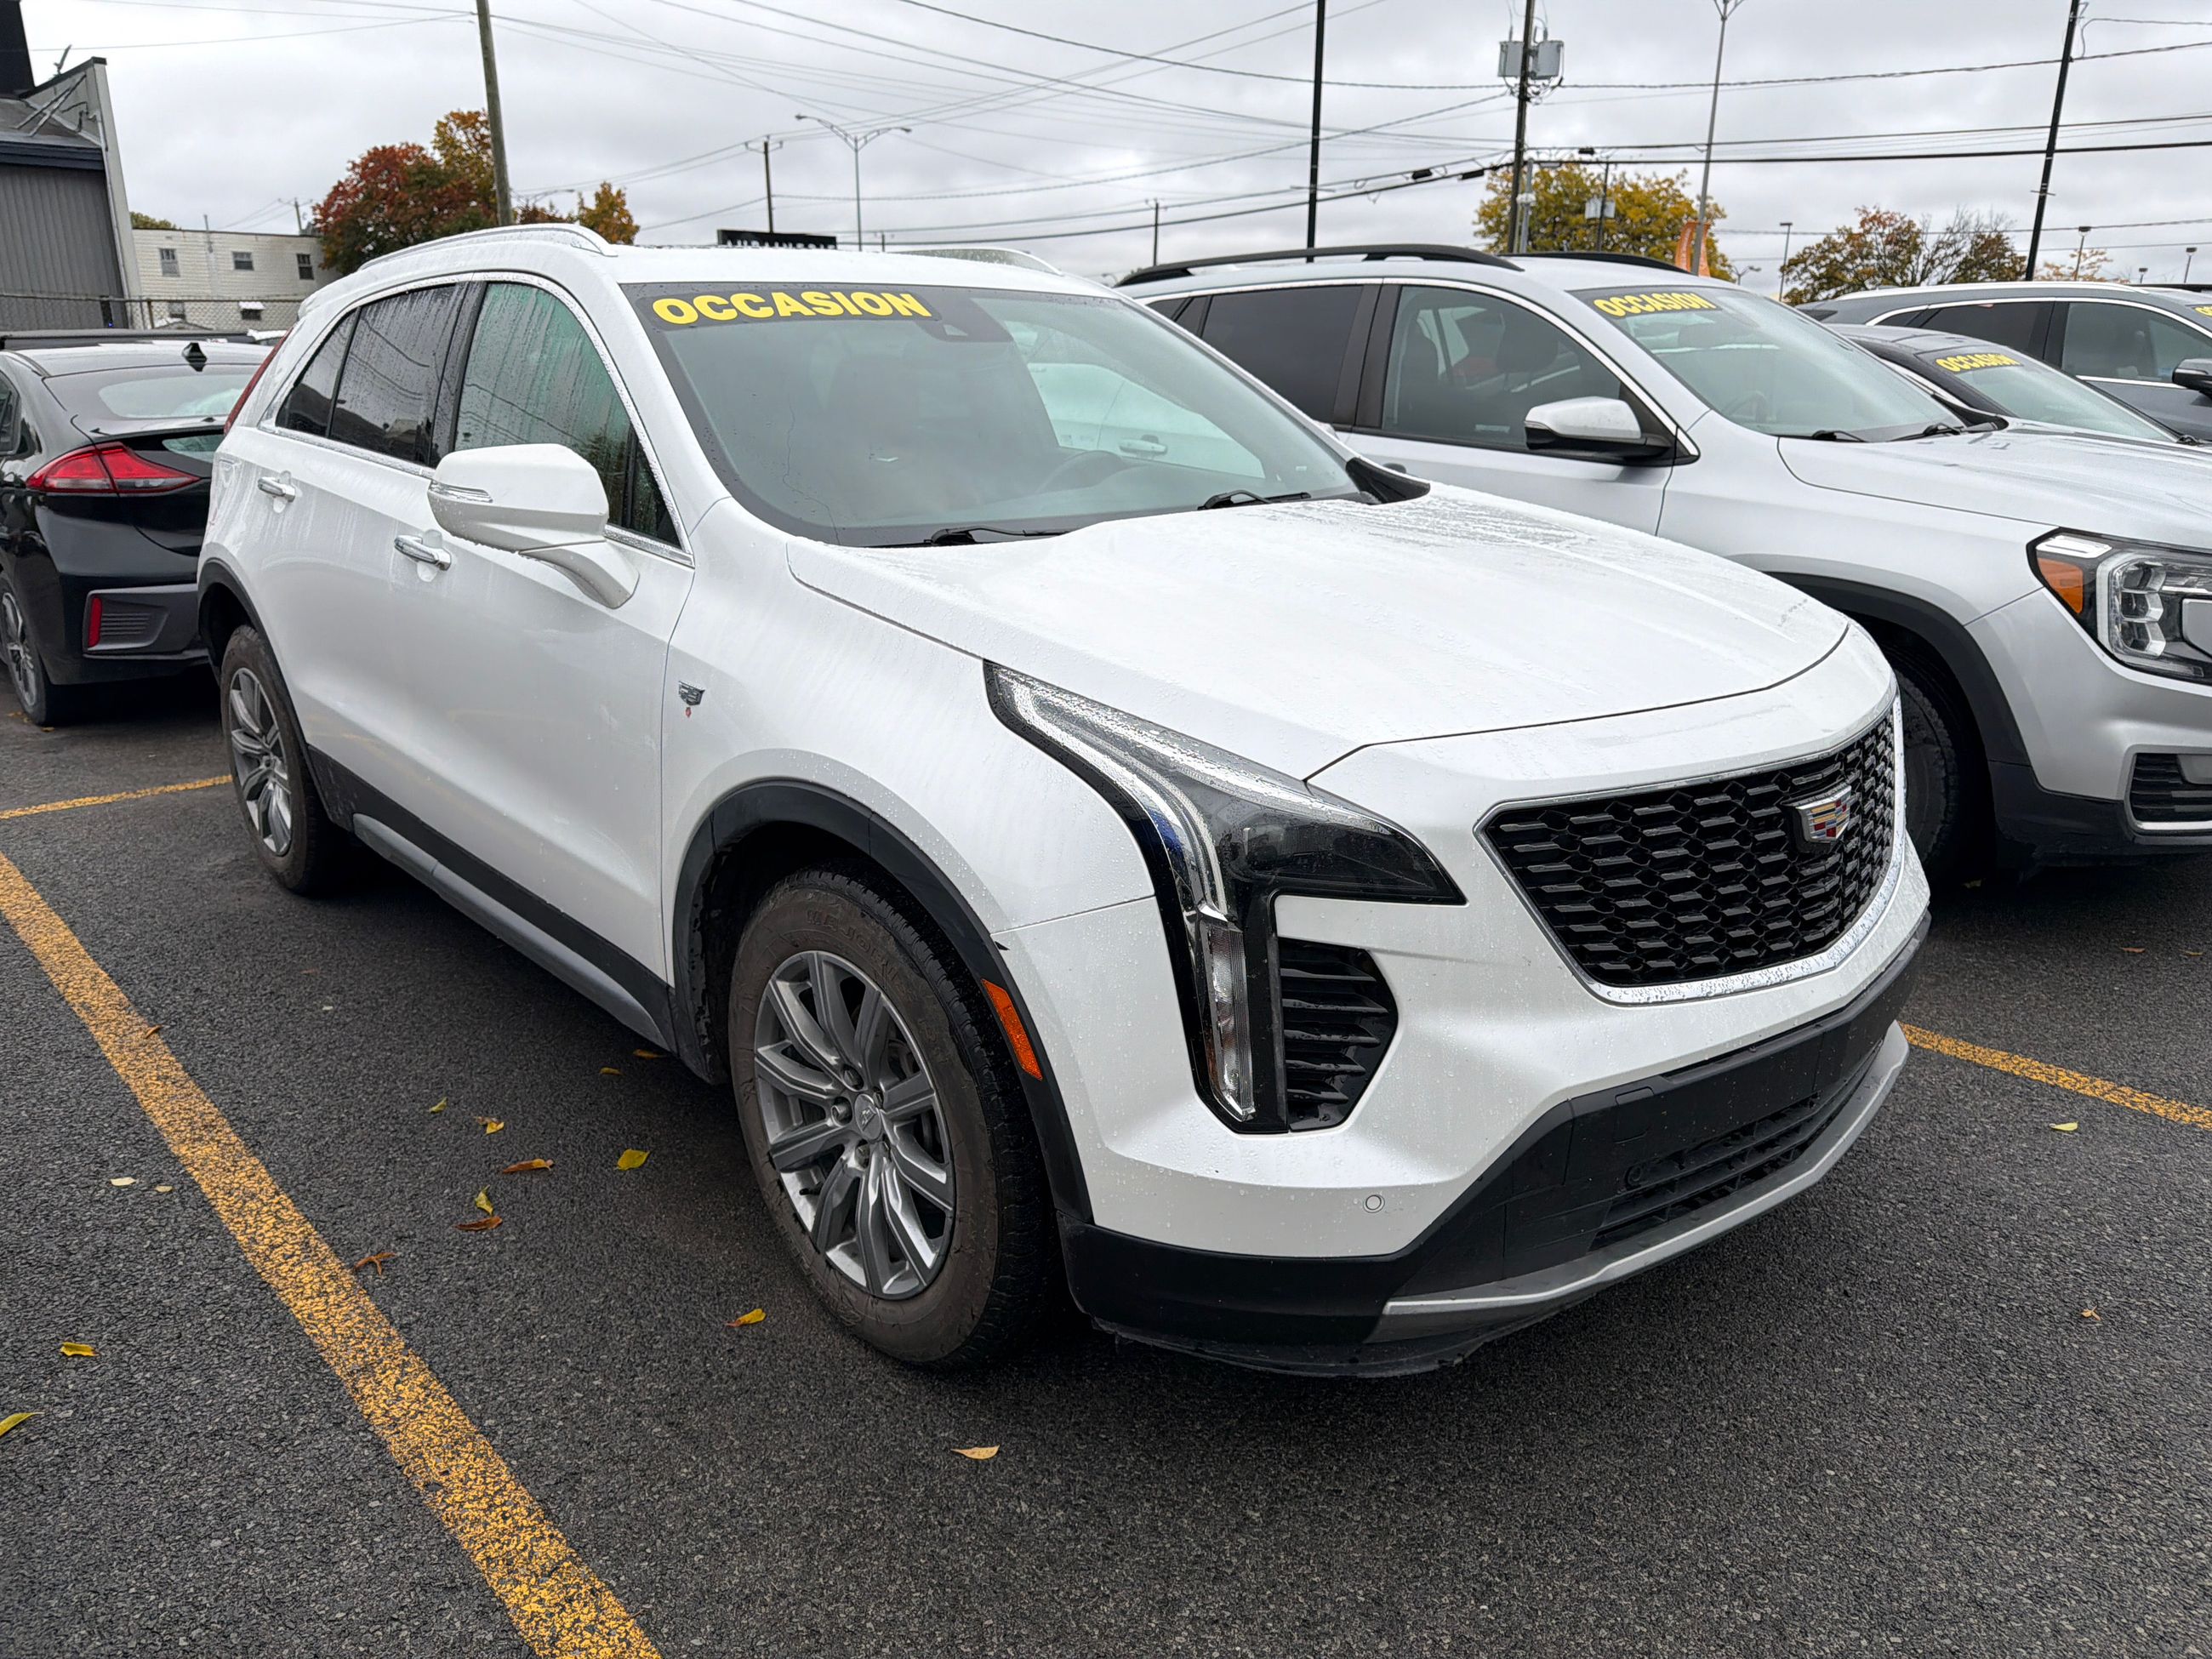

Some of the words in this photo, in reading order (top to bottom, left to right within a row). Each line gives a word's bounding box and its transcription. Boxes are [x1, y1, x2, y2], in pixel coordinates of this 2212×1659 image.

[652, 291, 932, 324] OCCASION
[1593, 292, 1717, 317] OCCASION
[1936, 353, 2022, 372] OCCASION
